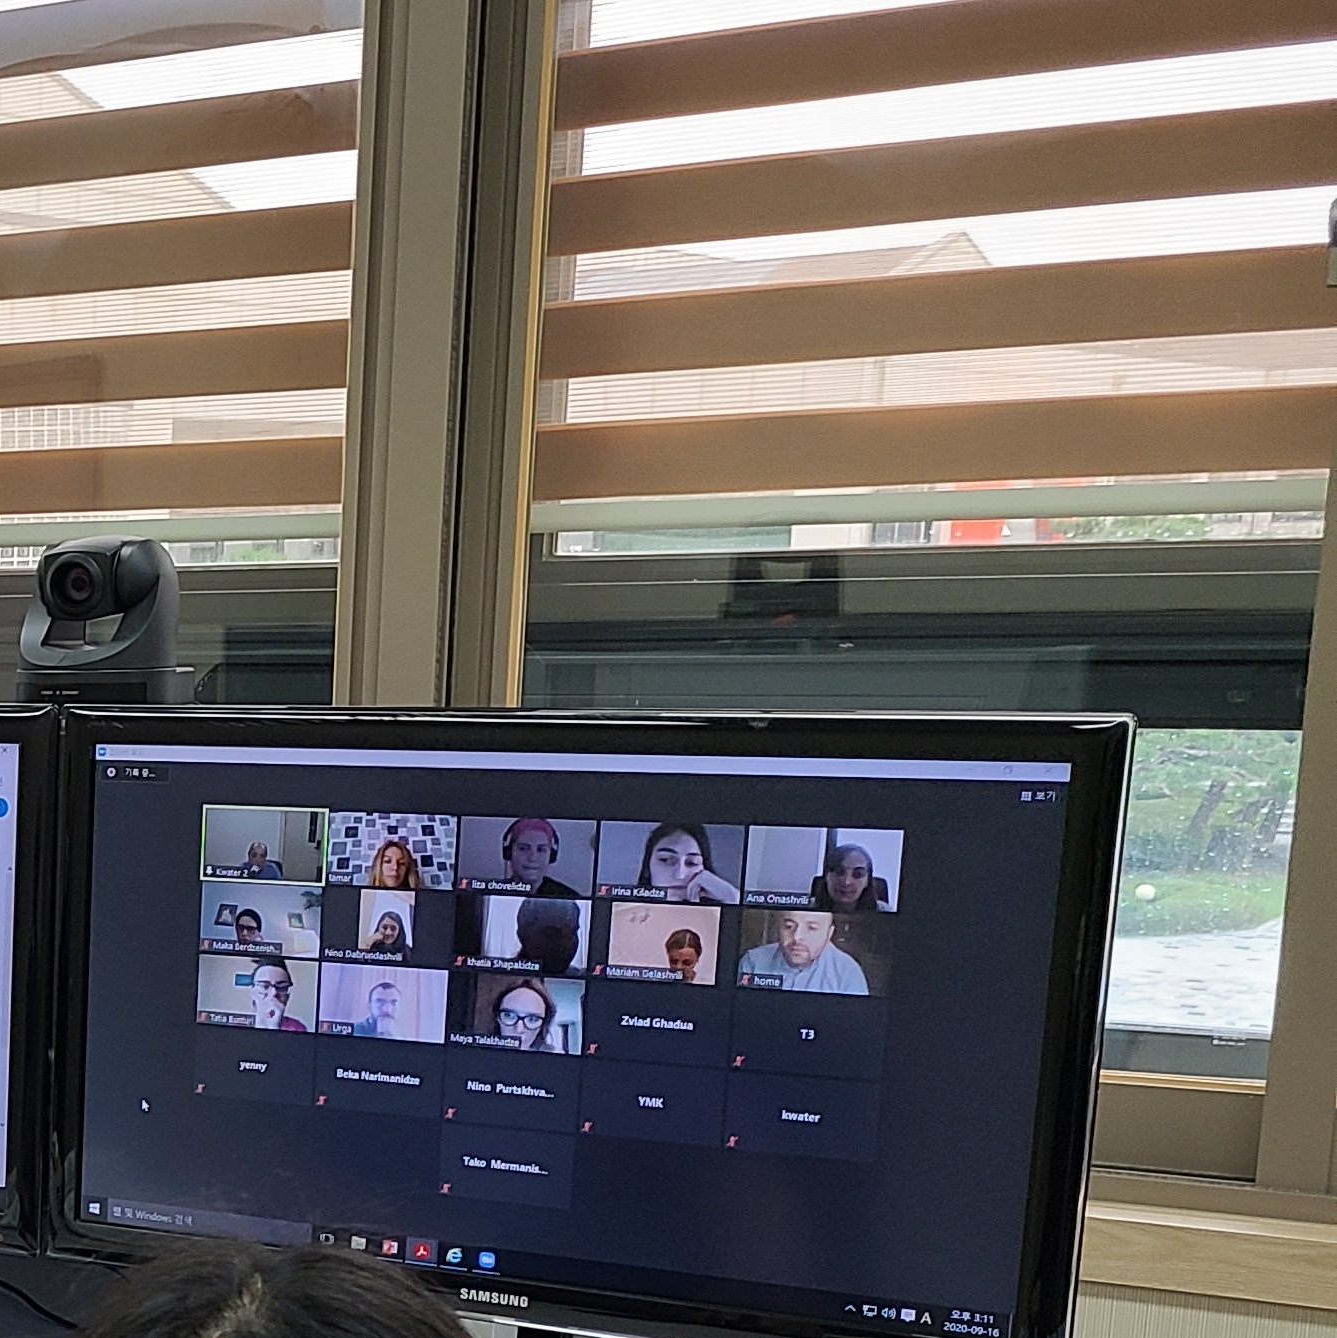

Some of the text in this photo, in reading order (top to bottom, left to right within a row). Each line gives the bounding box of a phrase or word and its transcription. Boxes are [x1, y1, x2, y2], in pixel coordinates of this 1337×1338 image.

[242, 868, 250, 878] 2
[611, 887, 631, 897] Irina
[746, 892, 764, 903] Ana
[324, 948, 344, 959] Nino
[606, 966, 640, 978] Mariam
[753, 975, 780, 987] home
[620, 1015, 694, 1032] Zviad Ghadua
[450, 1033, 473, 1045] Maya
[800, 1028, 815, 1040] T3
[239, 1061, 268, 1073] yenny
[336, 1069, 421, 1086] Beka Narimanidze
[466, 1080, 491, 1092] Nino
[638, 1096, 664, 1109] YMK
[781, 1110, 821, 1123] kwater
[462, 1156, 487, 1168] Tako
[135, 1209, 173, 1223] Windows
[459, 1287, 529, 1308] SAMSUNG
[920, 1312, 932, 1325] A
[949, 1309, 971, 1322] 오후
[943, 1321, 1000, 1337] 2020-09-16
